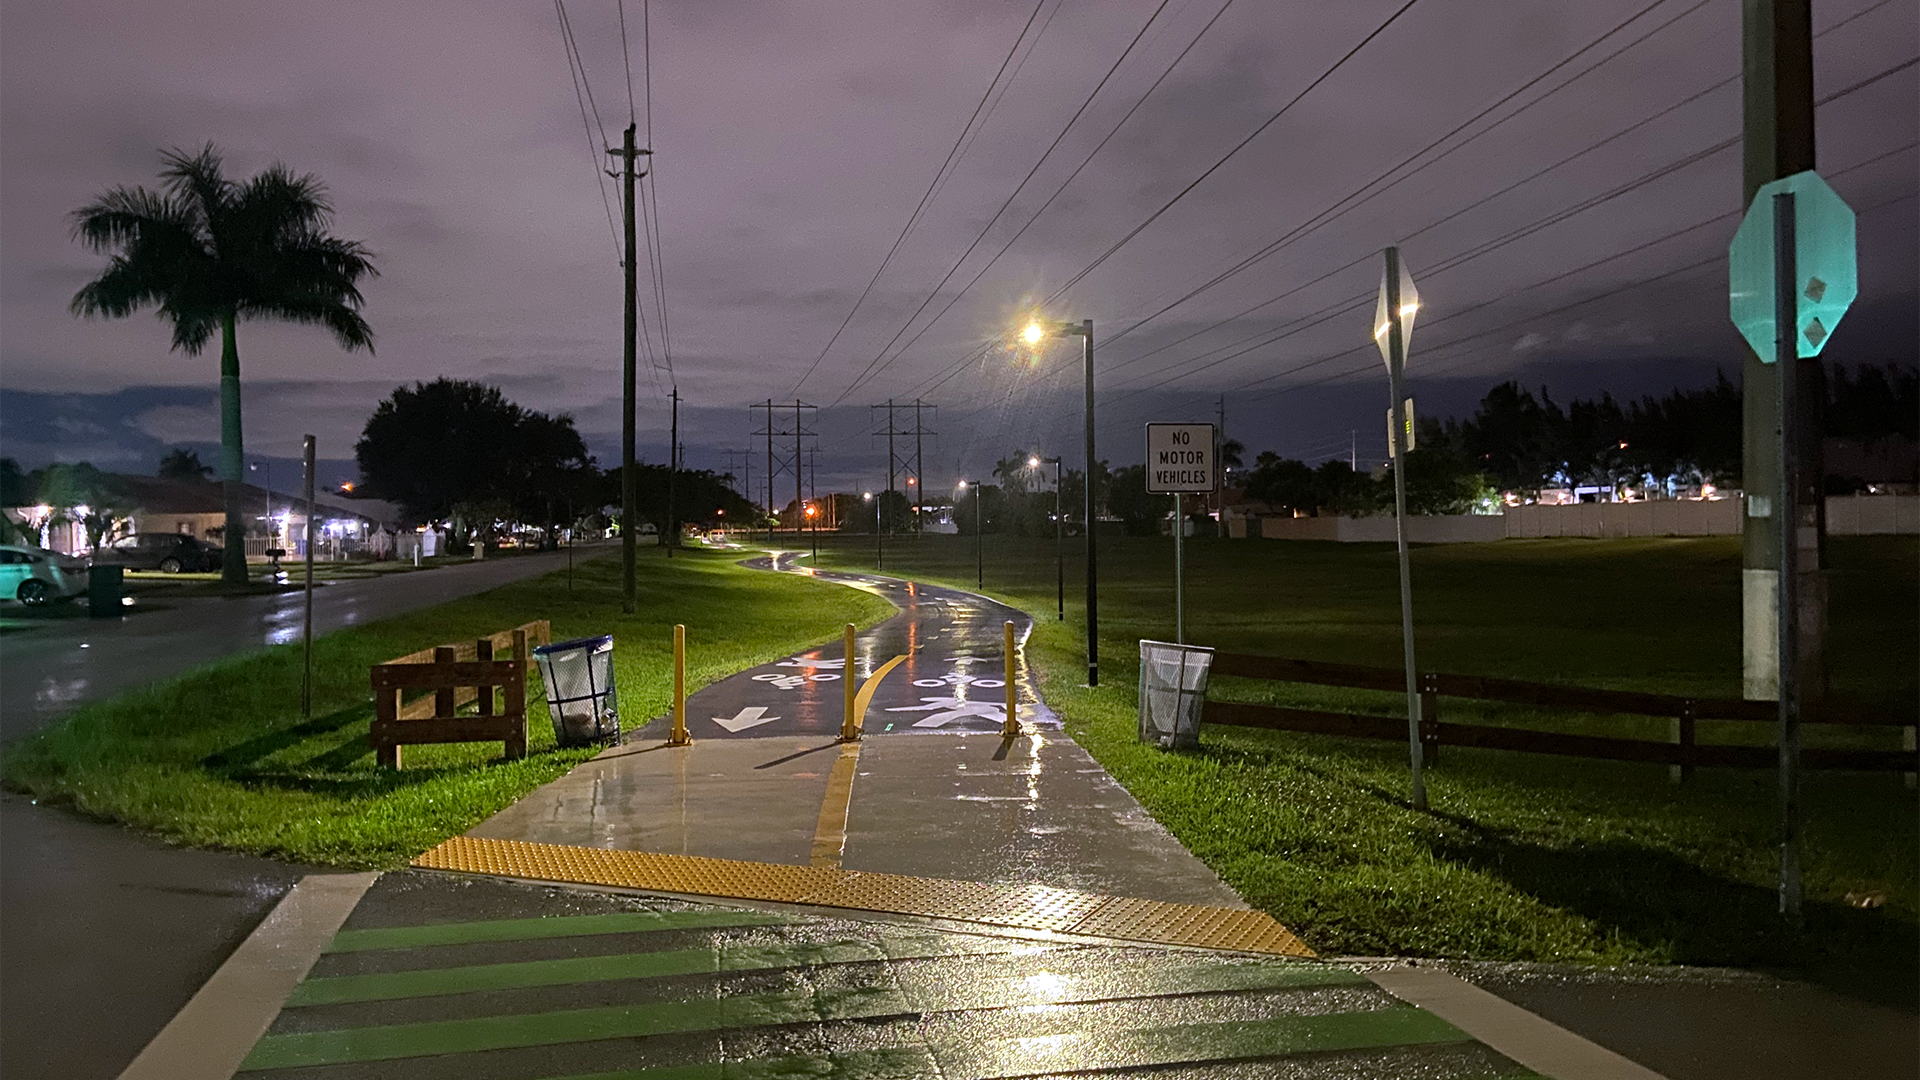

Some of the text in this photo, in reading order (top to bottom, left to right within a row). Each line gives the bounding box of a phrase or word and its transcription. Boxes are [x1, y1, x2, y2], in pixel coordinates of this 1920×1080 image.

[1172, 432, 1190, 445] NO
[1159, 451, 1204, 464] MOTOR
[1156, 470, 1206, 484] VEHICLES
